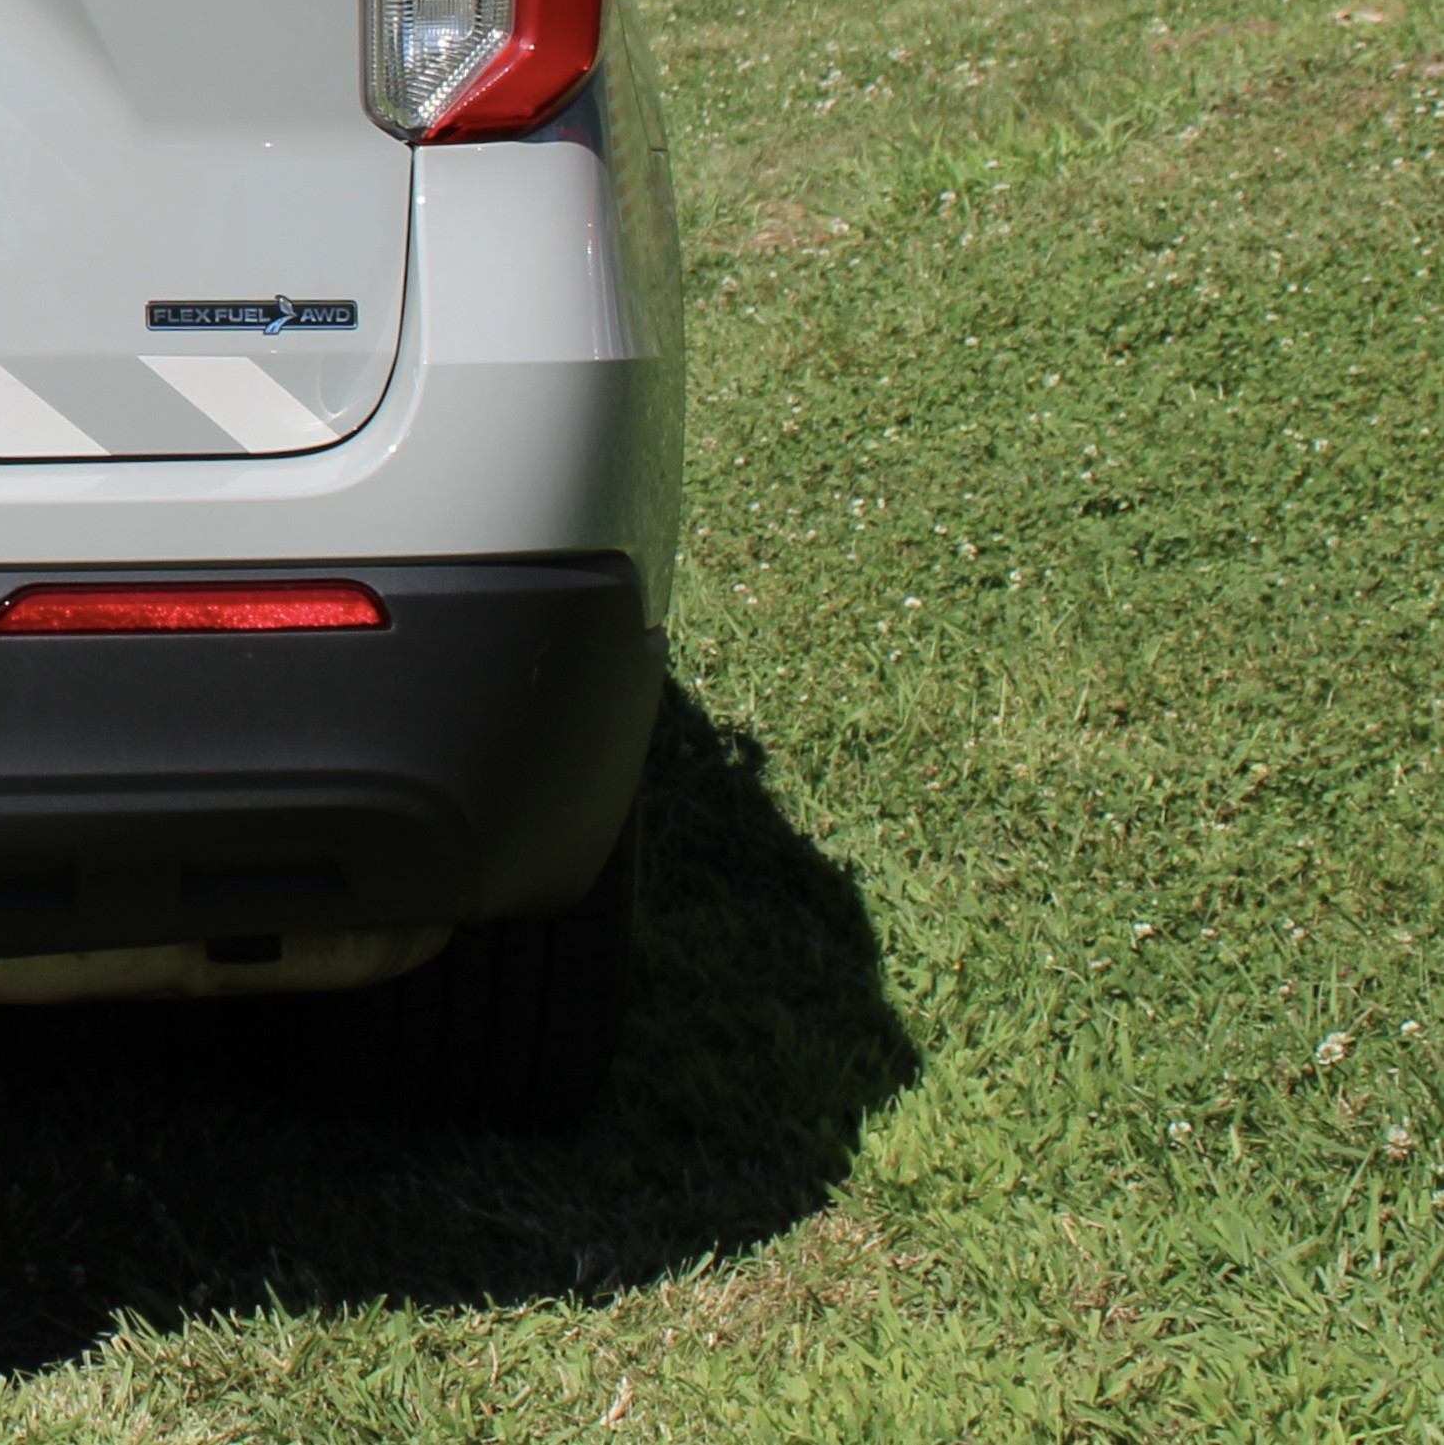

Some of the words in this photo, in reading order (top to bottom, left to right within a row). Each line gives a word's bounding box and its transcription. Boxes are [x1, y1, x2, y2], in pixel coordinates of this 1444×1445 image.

[153, 307, 211, 323] FLEX
[214, 307, 271, 324] FUEL
[299, 307, 352, 323] AWD
